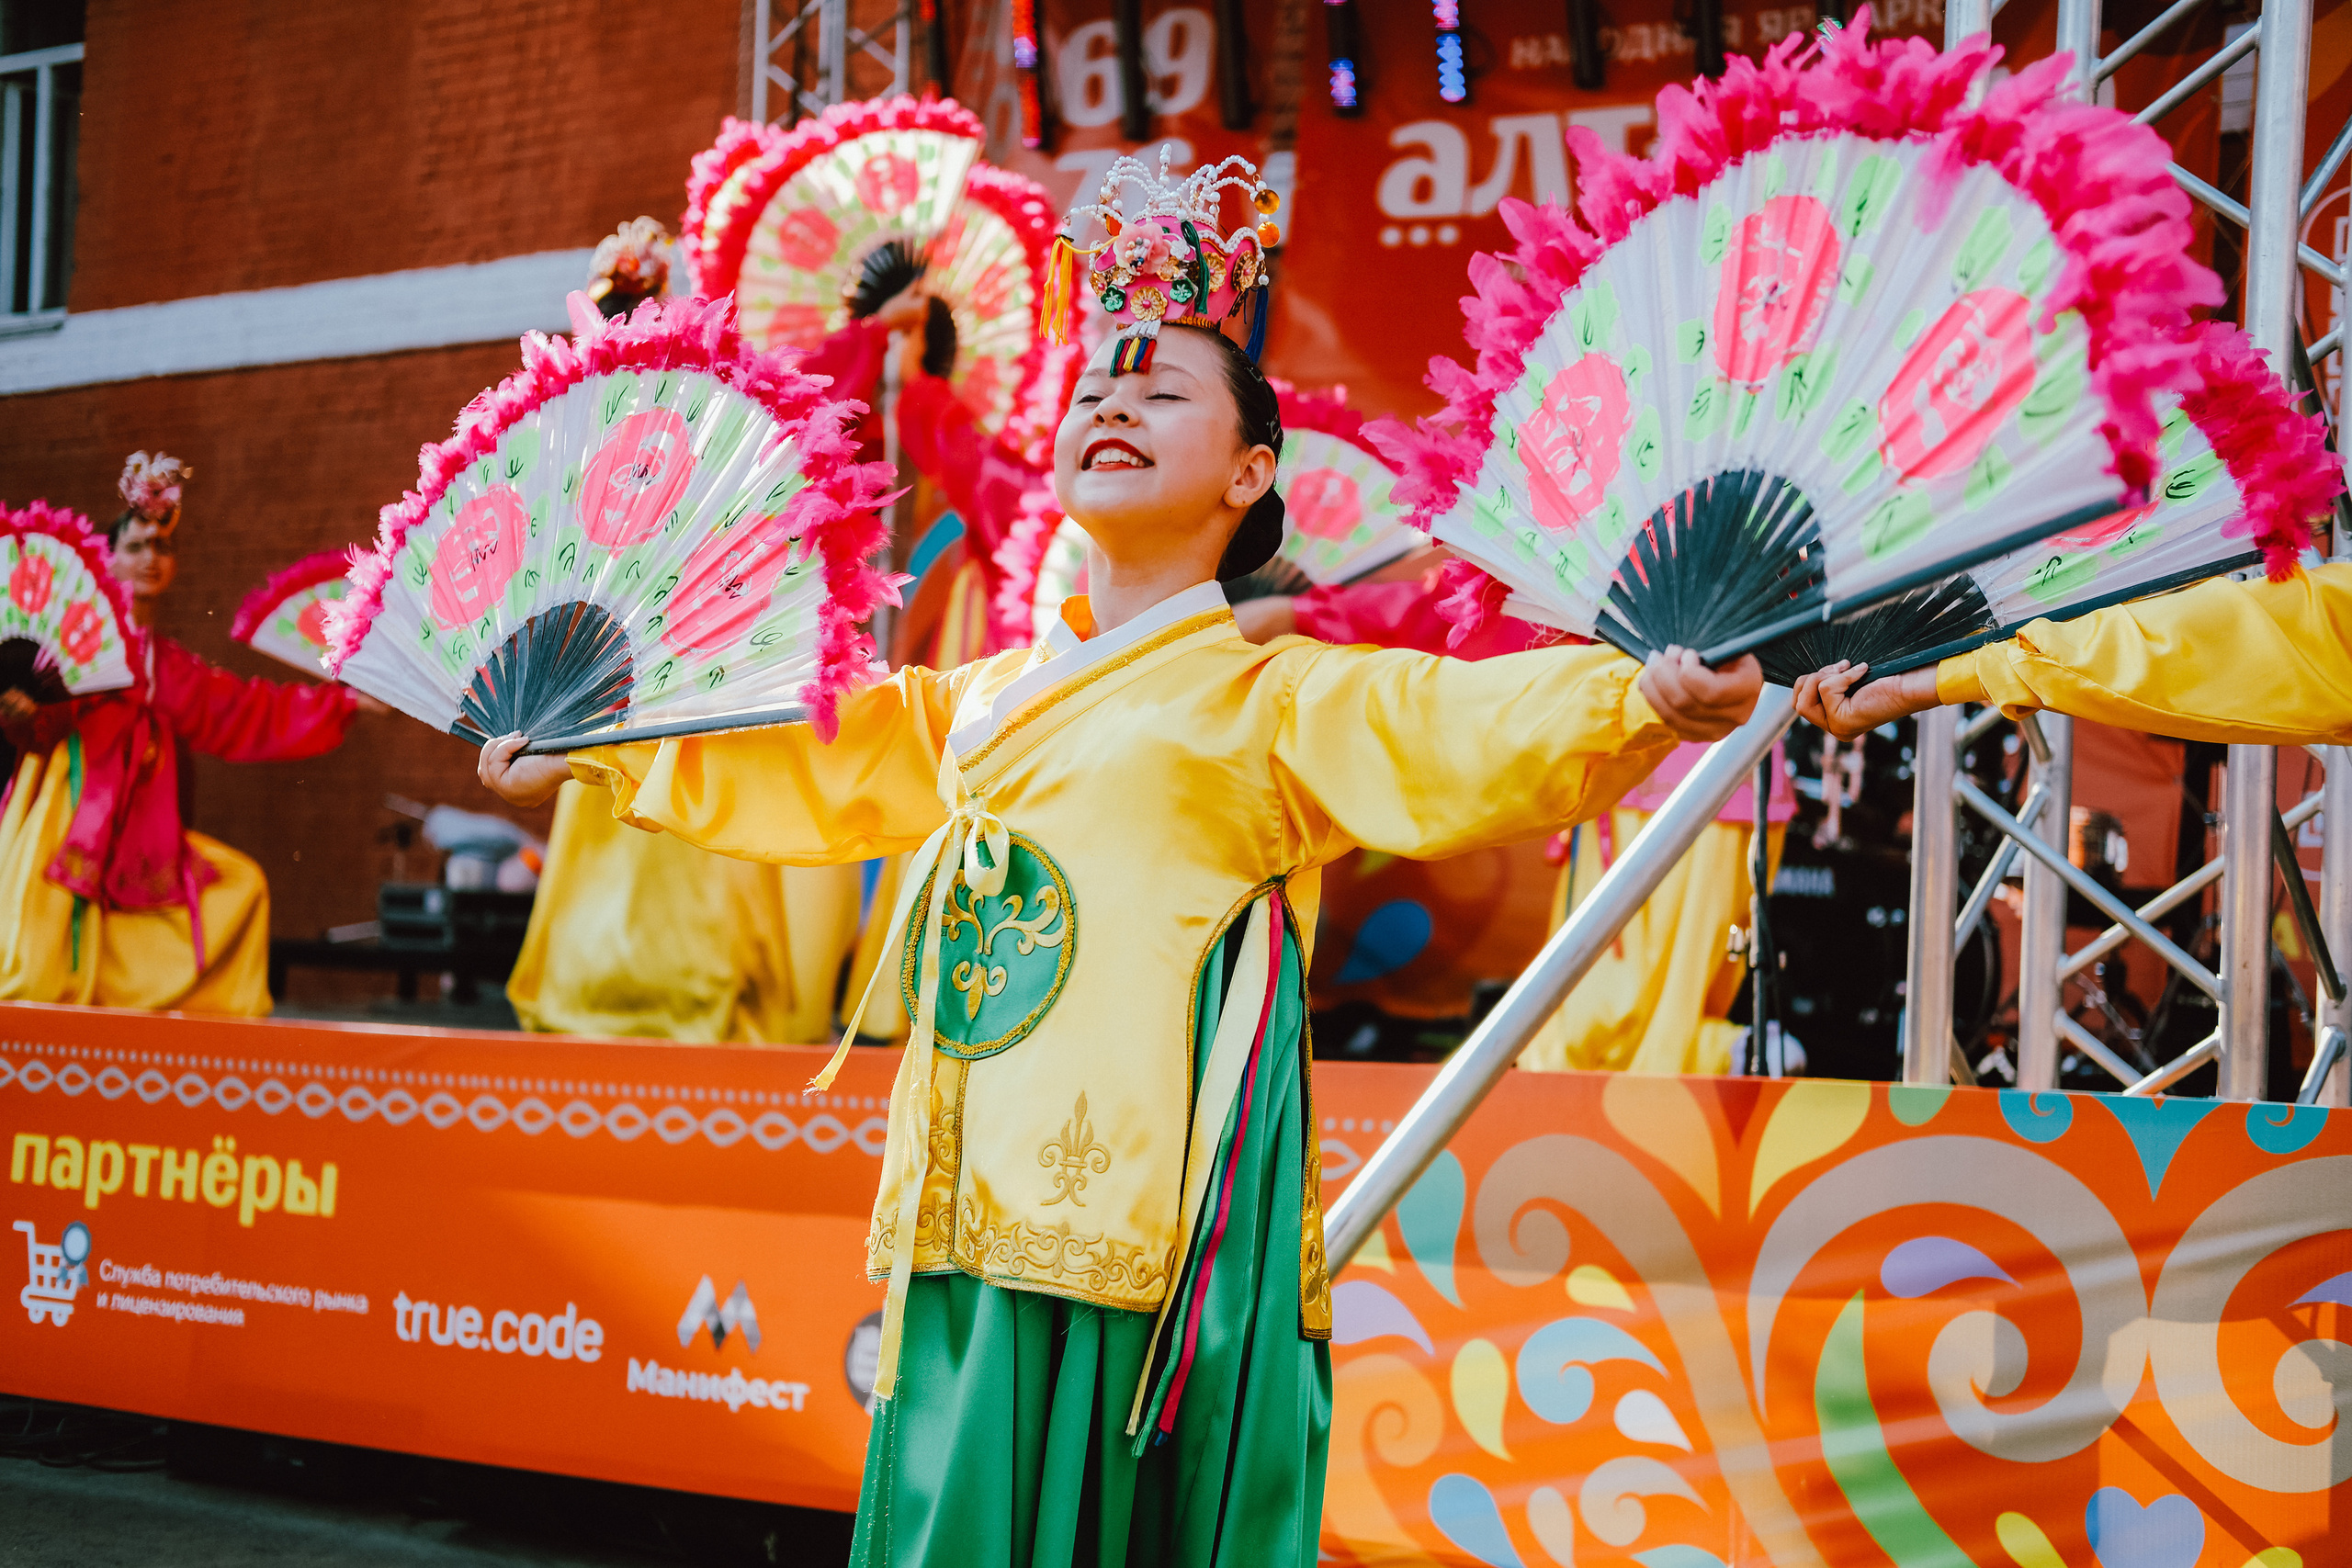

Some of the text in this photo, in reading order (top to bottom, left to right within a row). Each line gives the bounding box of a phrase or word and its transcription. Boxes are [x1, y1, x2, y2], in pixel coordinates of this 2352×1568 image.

[11, 1133, 339, 1227] партнёры
[96, 1291, 245, 1327] и лицензирования
[99, 1258, 369, 1314] Служба потребительского рынка
[393, 1290, 605, 1362] true.code
[627, 1357, 810, 1413] Манифест
